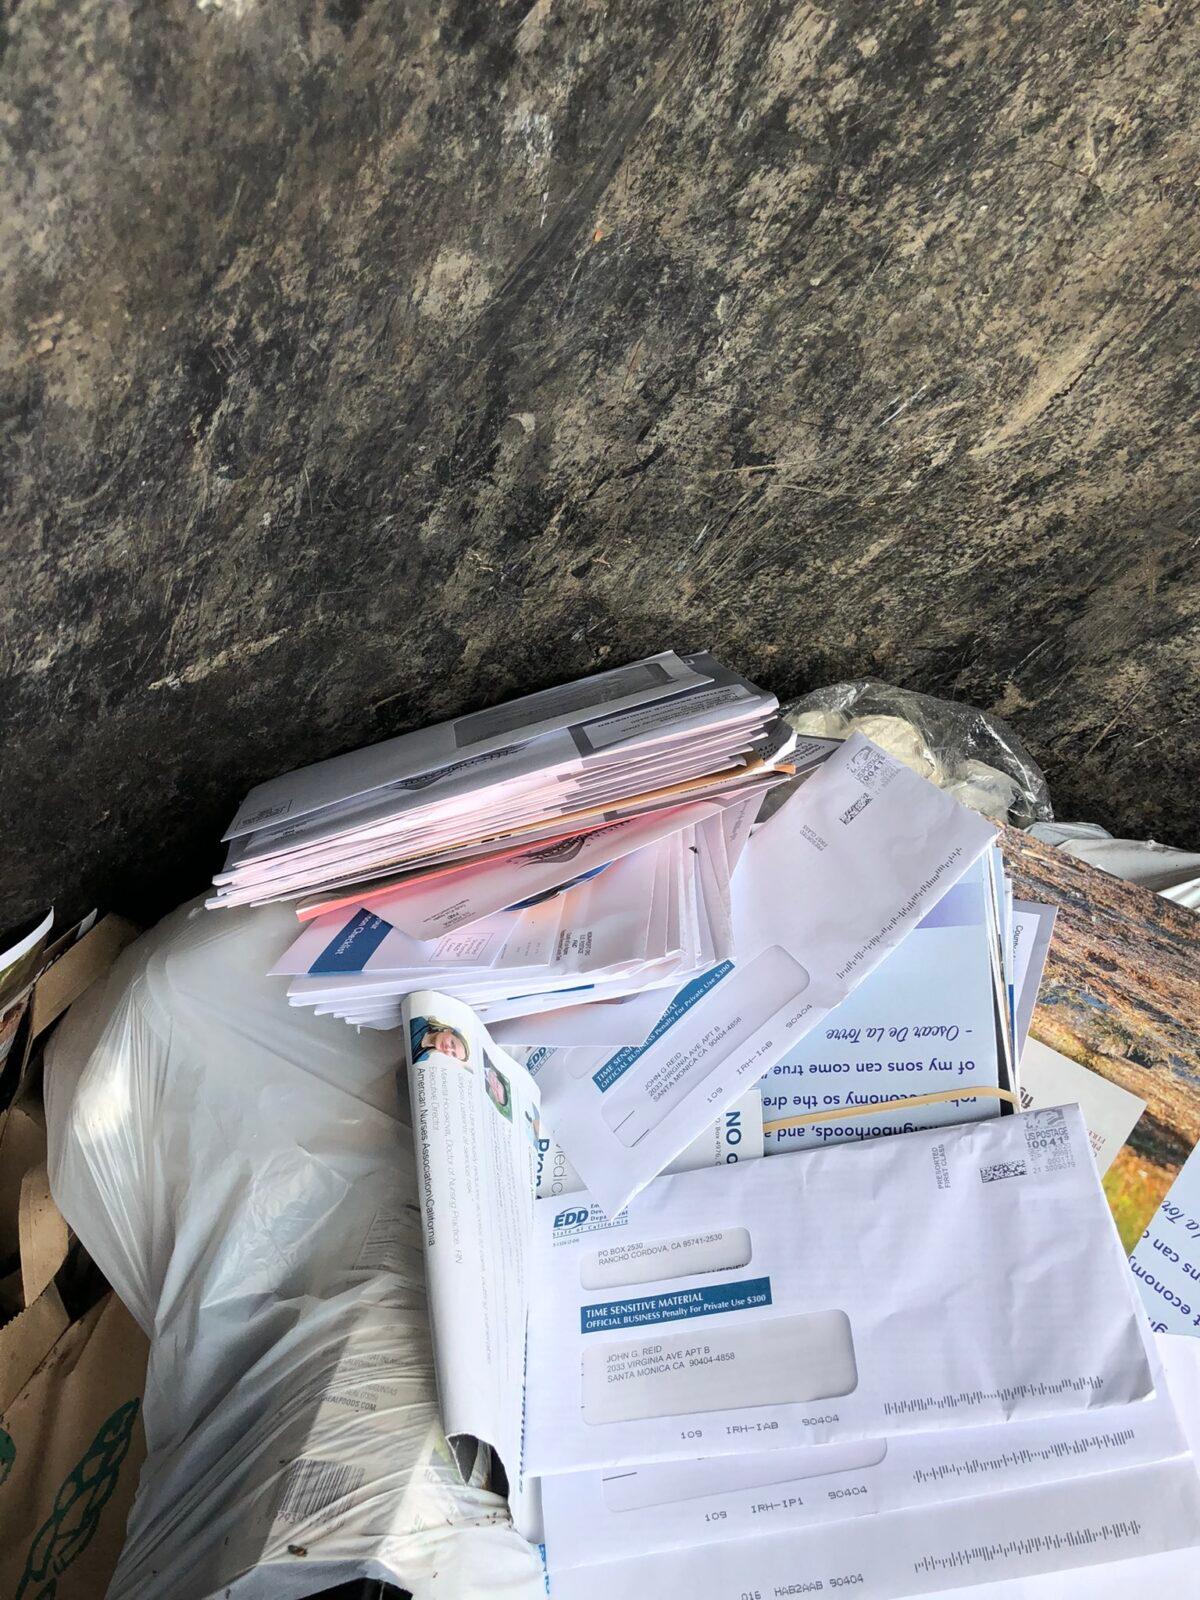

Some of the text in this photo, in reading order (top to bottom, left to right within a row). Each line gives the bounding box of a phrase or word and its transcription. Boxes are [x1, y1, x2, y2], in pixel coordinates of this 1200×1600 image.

[601, 1061, 628, 1088] OFFICIAL
[655, 1015, 676, 1036] Penalty
[684, 991, 703, 1009] Private
[702, 979, 716, 993] Use
[715, 962, 731, 981] $300
[786, 1004, 812, 1029] 90404
[826, 1028, 862, 1044] Torre
[866, 1028, 884, 1043] La
[888, 1026, 909, 1043] De
[913, 1025, 960, 1042] Oscar
[526, 1047, 547, 1070] EDD
[650, 1081, 664, 1096] 2033
[663, 1056, 690, 1083] VIRGINIA
[688, 1043, 702, 1056] AVE
[702, 1032, 715, 1046] APT
[809, 1063, 850, 1074] come
[856, 1062, 882, 1072] can
[888, 1062, 924, 1072] sons
[930, 1058, 953, 1070] my
[958, 1060, 976, 1074] of
[596, 1062, 614, 1082] TIME
[644, 1072, 662, 1091] JOHN
[666, 1052, 682, 1069] REID
[652, 1081, 674, 1102] SANTA
[674, 1058, 699, 1082] MONICA
[698, 1048, 708, 1058] CA
[418, 1068, 426, 1108] American
[762, 1097, 788, 1110] dre
[793, 1095, 818, 1107] the
[824, 1096, 840, 1104] so
[420, 1110, 428, 1141] Nurses
[726, 1111, 742, 1146] NO
[777, 1127, 806, 1141] and
[1036, 1126, 1068, 1138] POSTAGE
[446, 1139, 454, 1165] Doctor
[939, 1144, 949, 1167] CLASS
[932, 1146, 944, 1190] PRESORTED
[553, 1208, 589, 1229] EDD
[588, 1218, 628, 1232] California
[598, 1233, 722, 1266] RANCHO CORDOVA, CA 95741-2530
[598, 1243, 644, 1258] PO BOX 2530
[1153, 1238, 1180, 1262] can
[586, 1292, 704, 1318] TIME SENSITIVE MATERIAL
[586, 1294, 766, 1330] OFFICIAL BUSINESS Penalty For Private Use $300
[606, 1350, 630, 1363] JOHN
[642, 1345, 662, 1356] REID
[607, 1346, 710, 1373] 2033 VIRGINIA AVE APT B
[608, 1352, 736, 1383] SANTA MONICA CA 90404-4858
[680, 1430, 703, 1440] 109
[802, 1414, 840, 1427] 90404
[704, 1511, 728, 1522] 109
[828, 1486, 868, 1500] 90404
[830, 1574, 864, 1588] 90404
